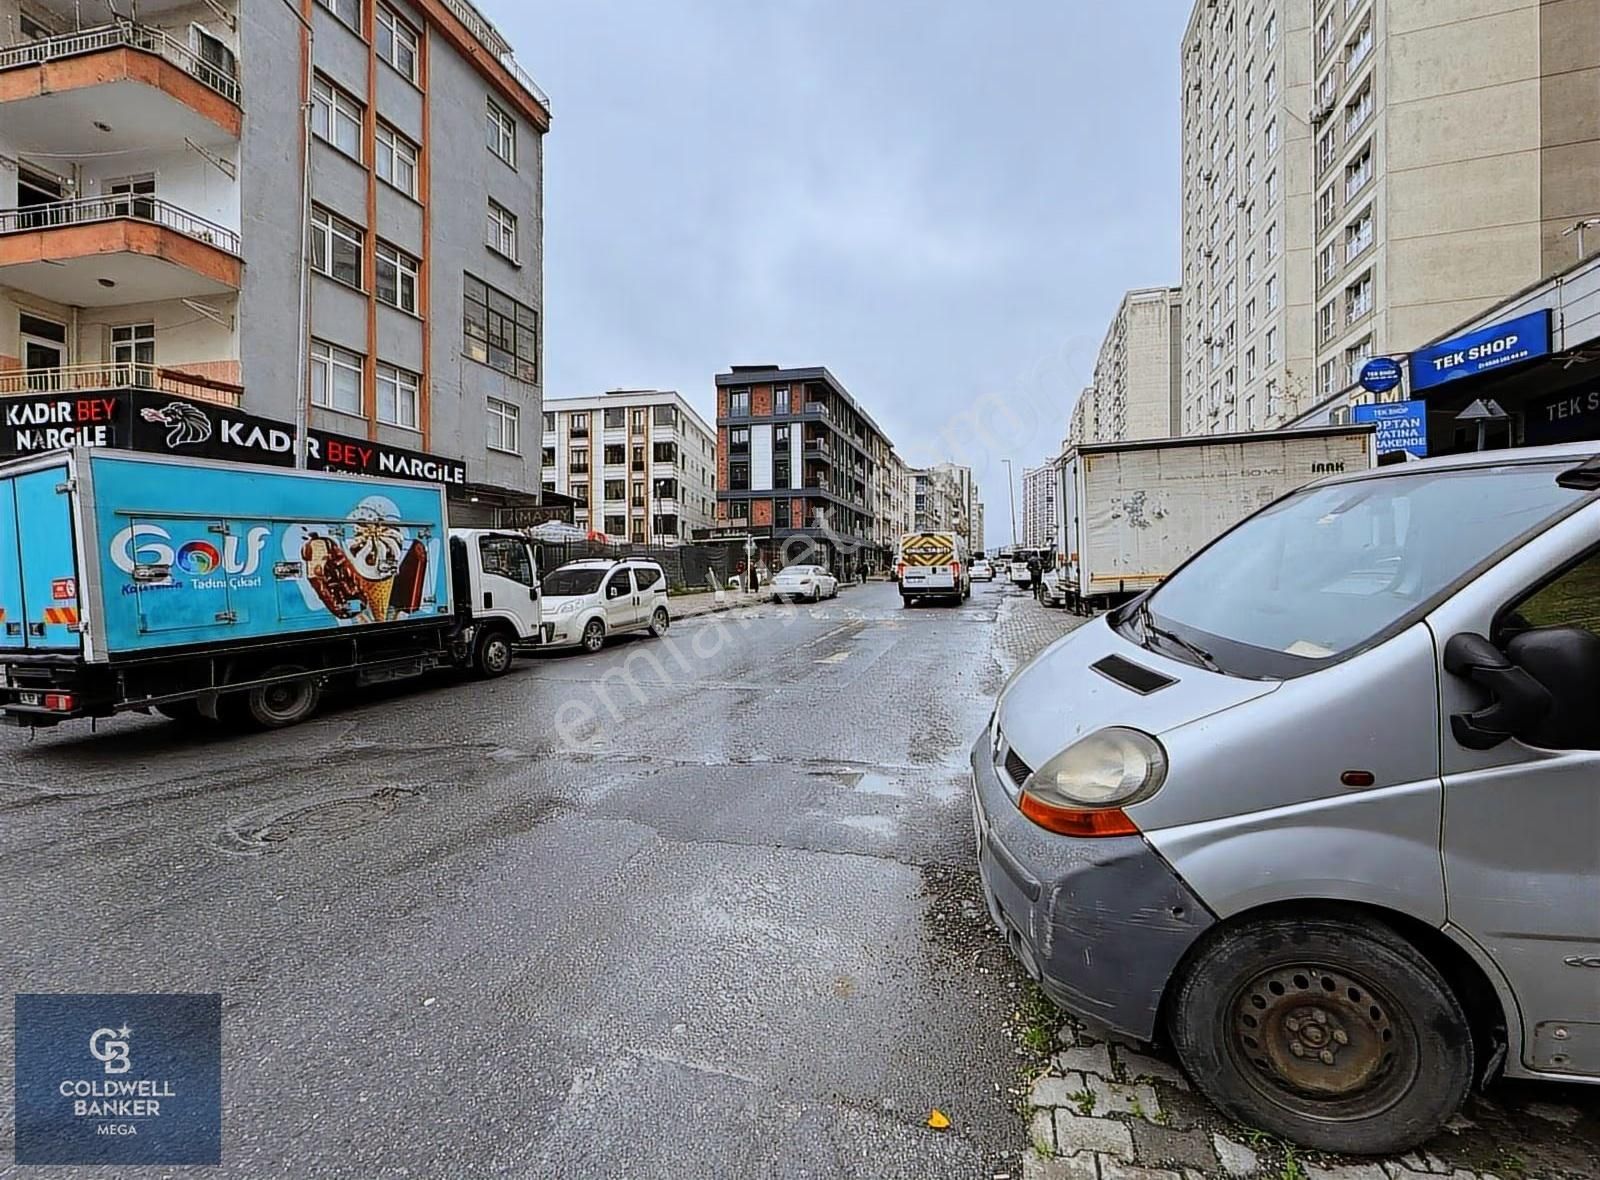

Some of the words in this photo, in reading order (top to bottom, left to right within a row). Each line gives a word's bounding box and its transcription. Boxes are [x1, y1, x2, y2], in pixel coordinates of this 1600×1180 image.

[1433, 353, 1464, 370] TEK
[1467, 335, 1518, 360] SHOP
[77, 398, 116, 421] BEY
[1545, 395, 1581, 421] TEK
[1587, 391, 1600, 410] S
[1376, 417, 1420, 429] OPTAN
[1376, 428, 1418, 439] YATINA
[327, 440, 373, 468] BEY
[110, 524, 272, 586] Golf
